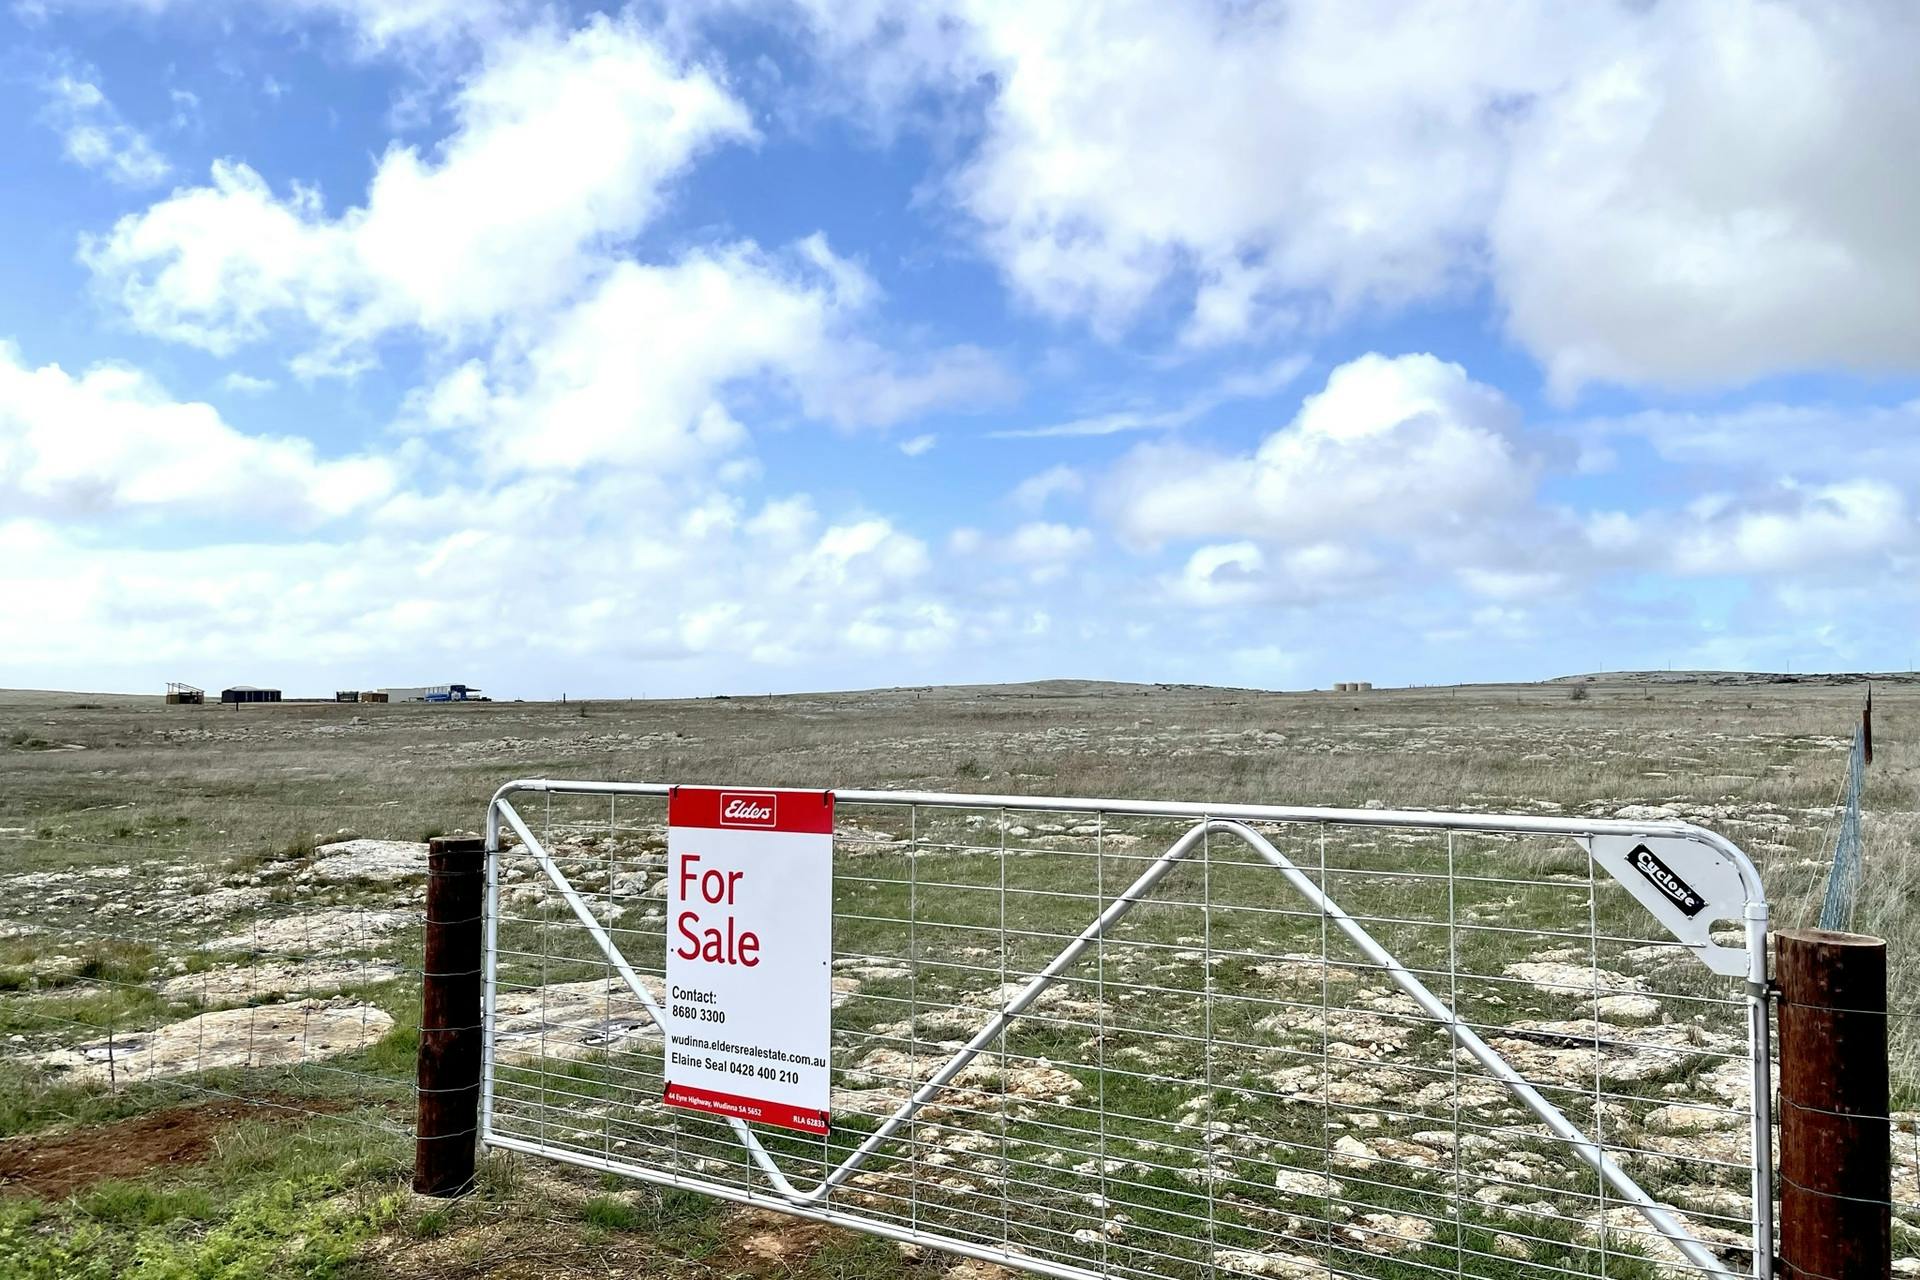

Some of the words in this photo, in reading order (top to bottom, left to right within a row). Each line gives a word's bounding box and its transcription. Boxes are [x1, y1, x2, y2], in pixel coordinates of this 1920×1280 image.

[724, 799, 772, 820] Elders
[680, 854, 744, 905] For
[1637, 851, 1696, 907] Cyclone
[677, 911, 760, 967] Sale
[672, 985, 717, 1004] Contact:
[672, 1004, 697, 1019] 8680
[700, 1009, 726, 1024] 3300
[671, 1034, 826, 1068] wudinna.eldersrealestate.com.au
[671, 1052, 702, 1068] Elaine
[705, 1057, 727, 1073] Seal
[729, 1062, 755, 1077] 0428
[757, 1066, 776, 1081] 400
[779, 1070, 799, 1085] 210
[668, 1092, 675, 1100] 44
[676, 1094, 688, 1103] Eyre
[688, 1096, 713, 1108] Highway,
[713, 1101, 738, 1112] Wudinna
[738, 1105, 747, 1114] SA
[747, 1108, 762, 1117] 5652
[793, 1115, 806, 1125] RLA
[806, 1118, 826, 1128] 62833
